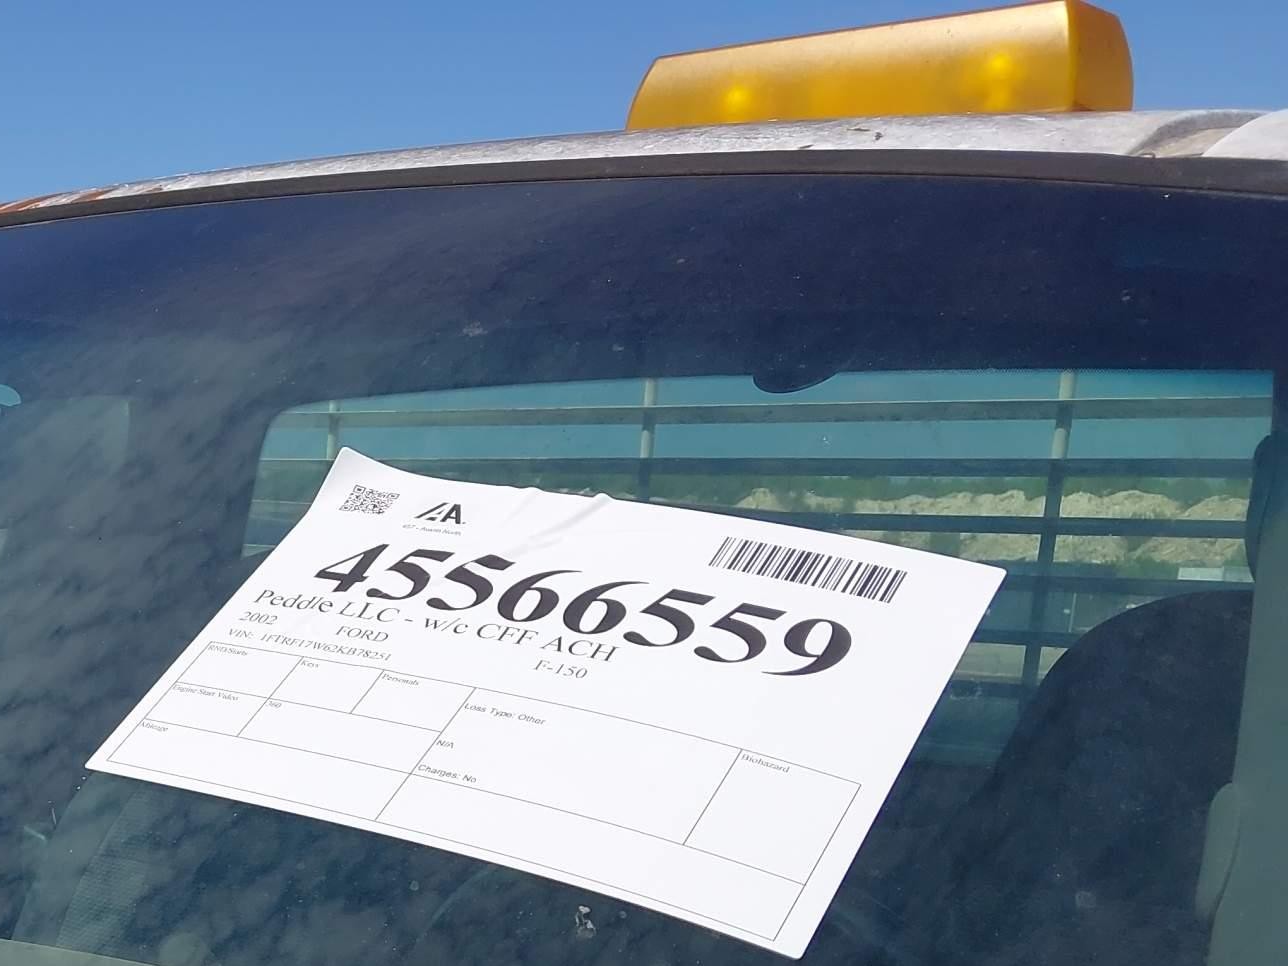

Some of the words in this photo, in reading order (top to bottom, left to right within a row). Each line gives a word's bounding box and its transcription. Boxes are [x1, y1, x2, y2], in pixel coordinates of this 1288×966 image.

[314, 543, 853, 677] 45566559
[228, 628, 254, 640] VIN:
[239, 611, 279, 626] 2002
[335, 625, 390, 643] FORD
[254, 589, 334, 613] Peddle
[338, 602, 401, 623] LLC
[425, 617, 469, 634] w/c
[476, 623, 540, 645] CFF
[541, 635, 621, 662] ACH
[381, 672, 420, 687] Personals
[533, 659, 589, 680] F-150
[464, 702, 487, 713] Loss
[489, 707, 514, 719] Type:
[517, 713, 547, 725] Other
[435, 739, 455, 749] N/A
[417, 763, 462, 779] Charges:
[462, 774, 477, 783] No
[741, 753, 791, 773] Biohazard
